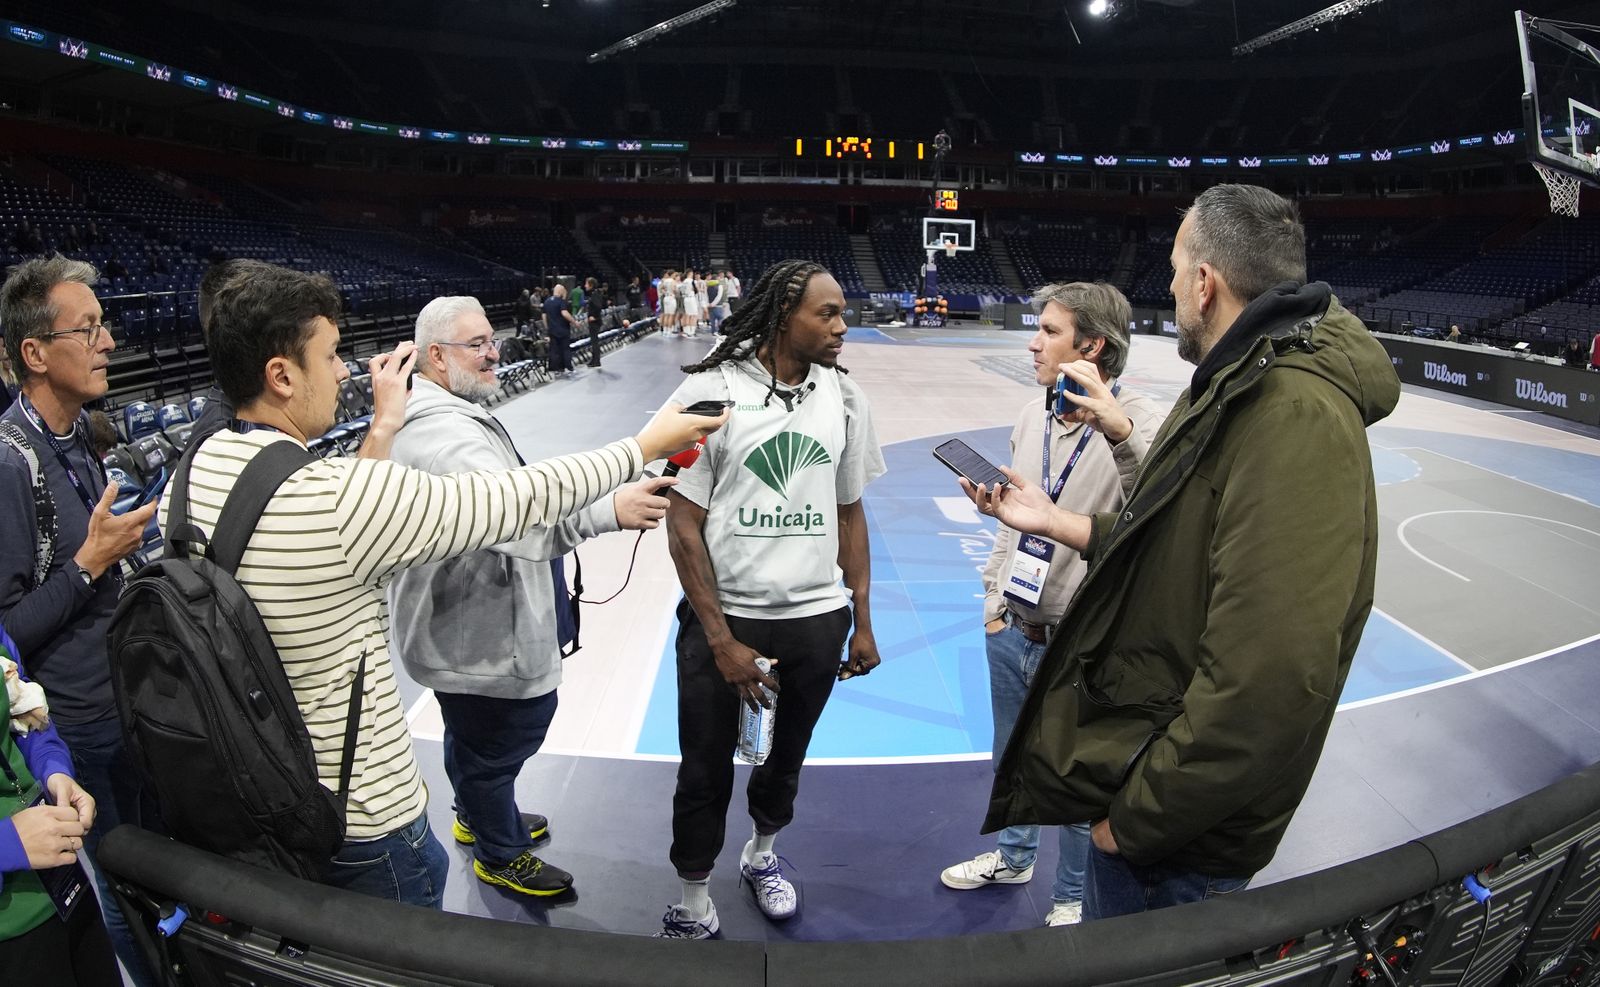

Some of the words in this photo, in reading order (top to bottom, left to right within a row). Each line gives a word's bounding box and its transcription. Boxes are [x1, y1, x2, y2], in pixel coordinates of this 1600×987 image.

[1423, 361, 1468, 387] Wilson
[1515, 378, 1568, 408] Wilson
[738, 504, 825, 532] Unicaja
